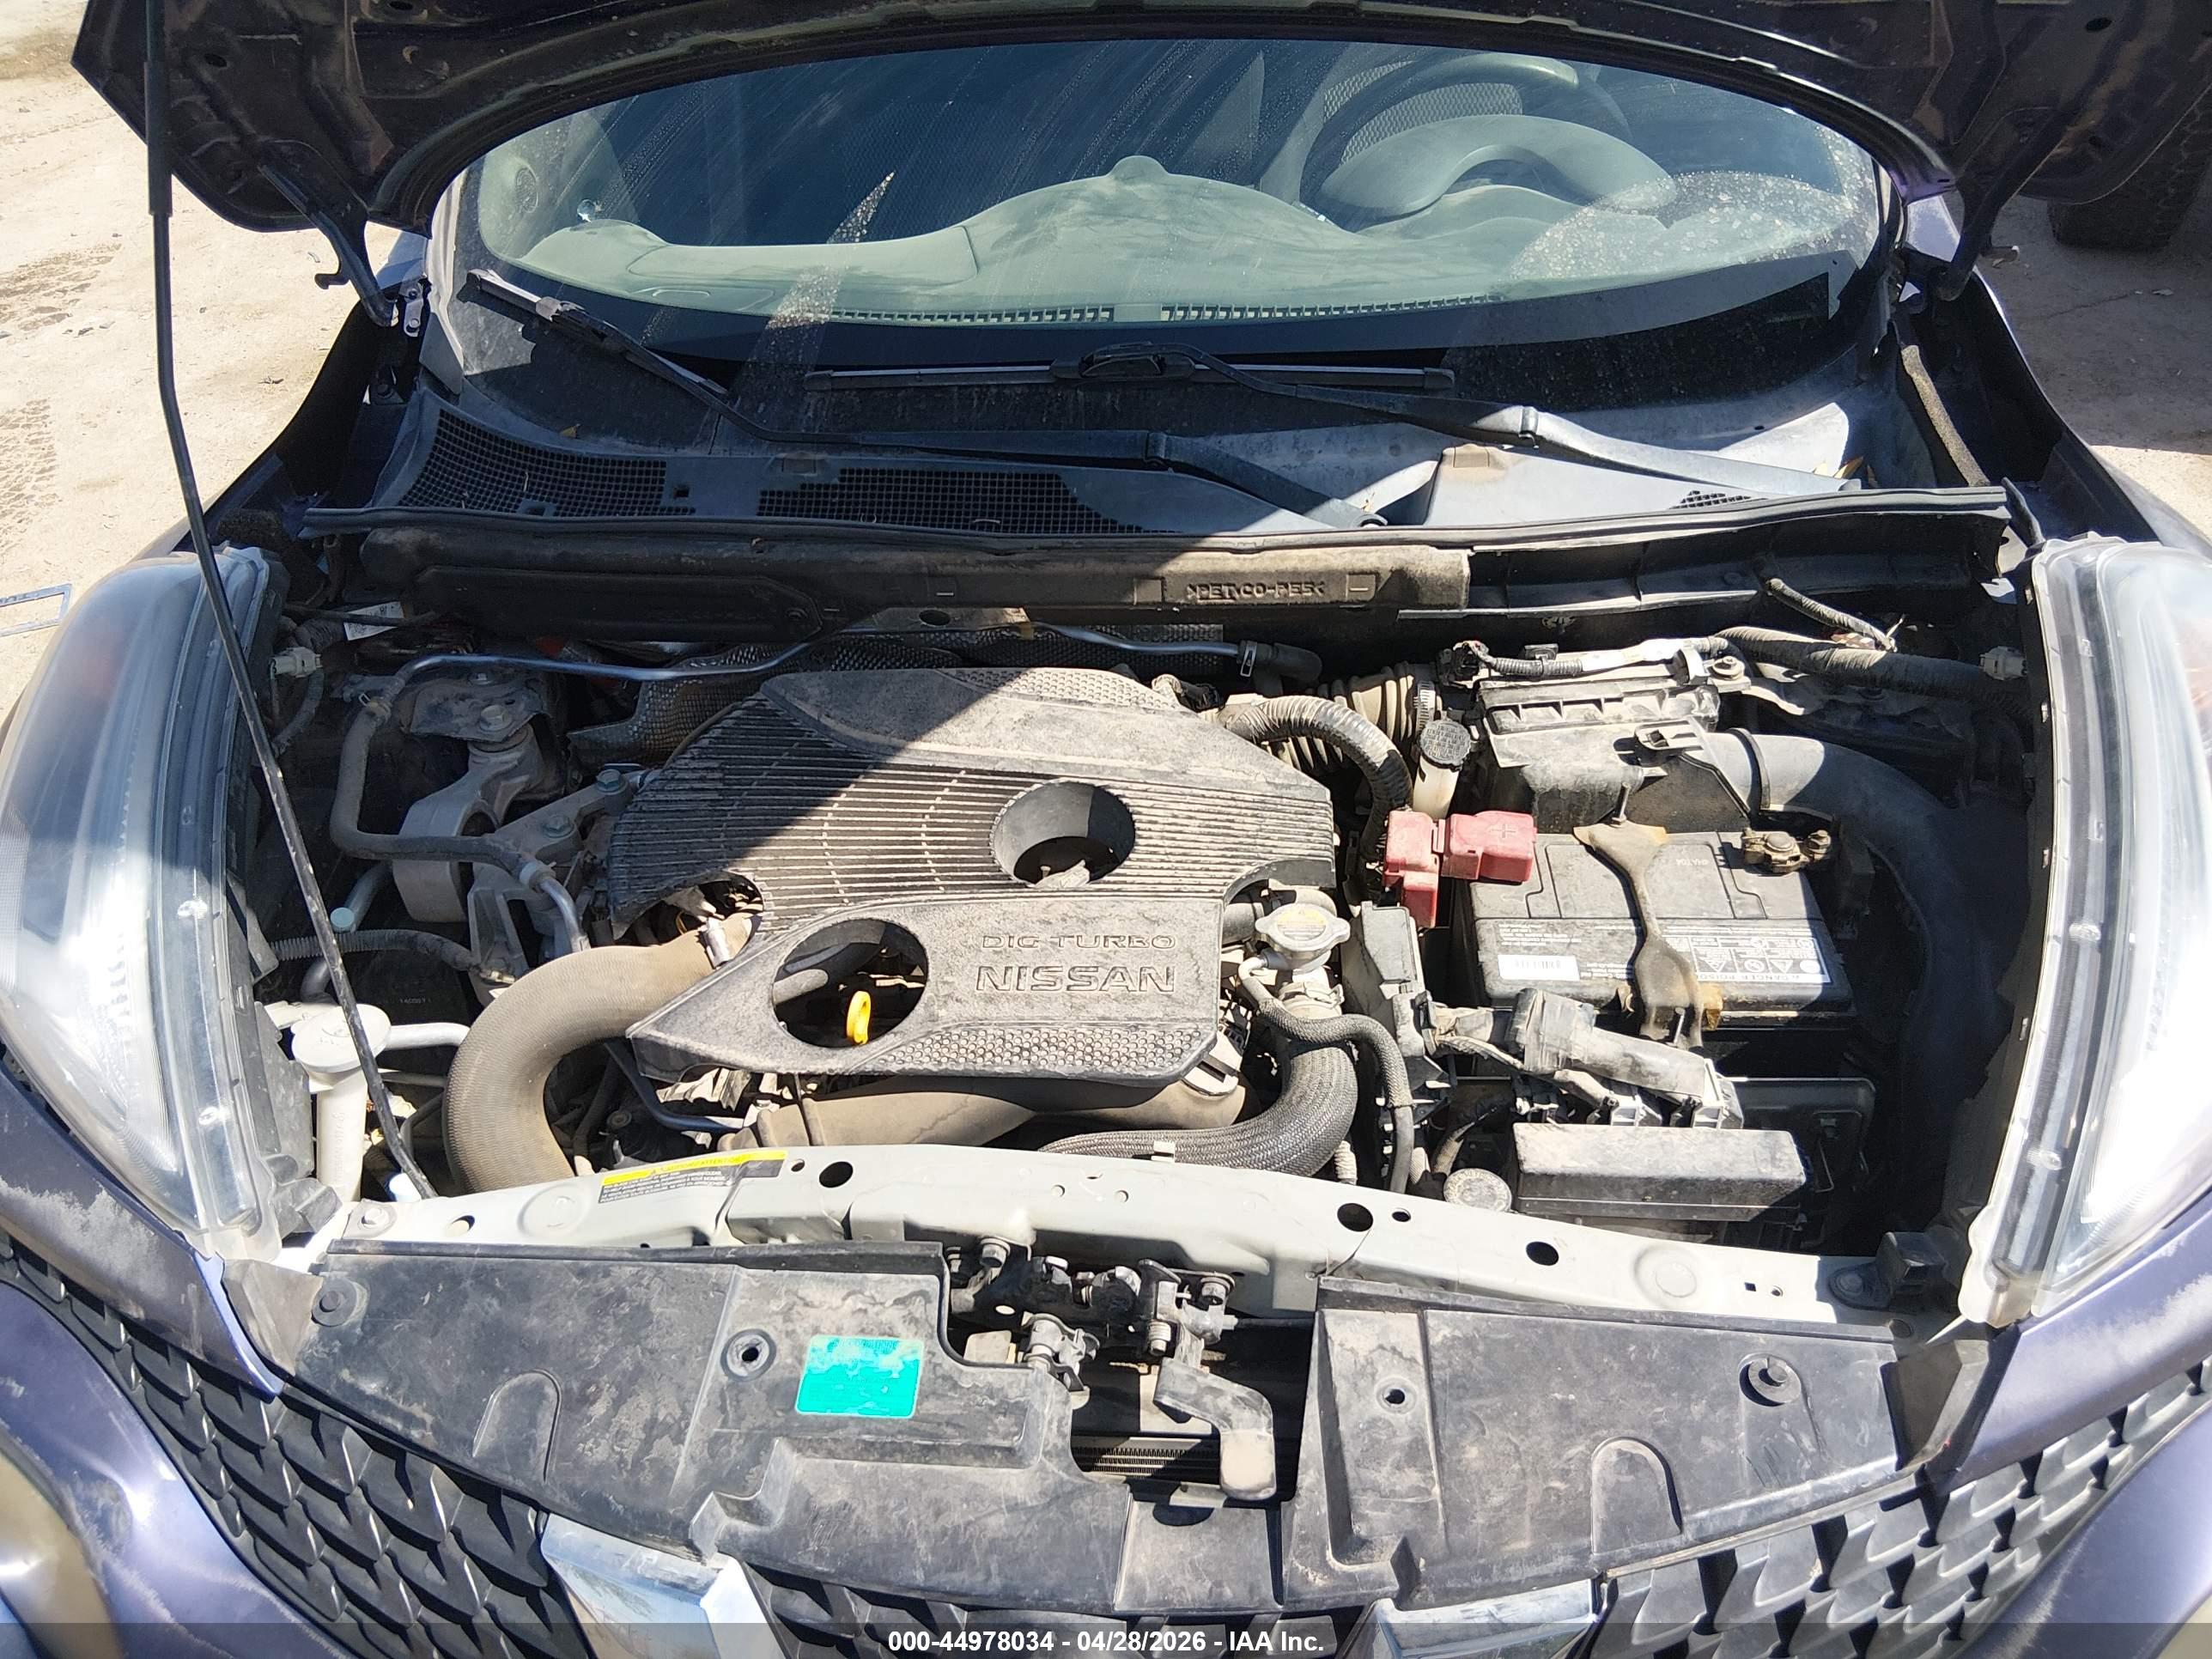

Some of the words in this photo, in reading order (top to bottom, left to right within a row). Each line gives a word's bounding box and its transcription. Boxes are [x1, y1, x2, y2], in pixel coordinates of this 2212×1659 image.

[982, 935, 1039, 949] DIG
[1049, 935, 1176, 949] TURBO
[976, 965, 1176, 993] NISSAN
